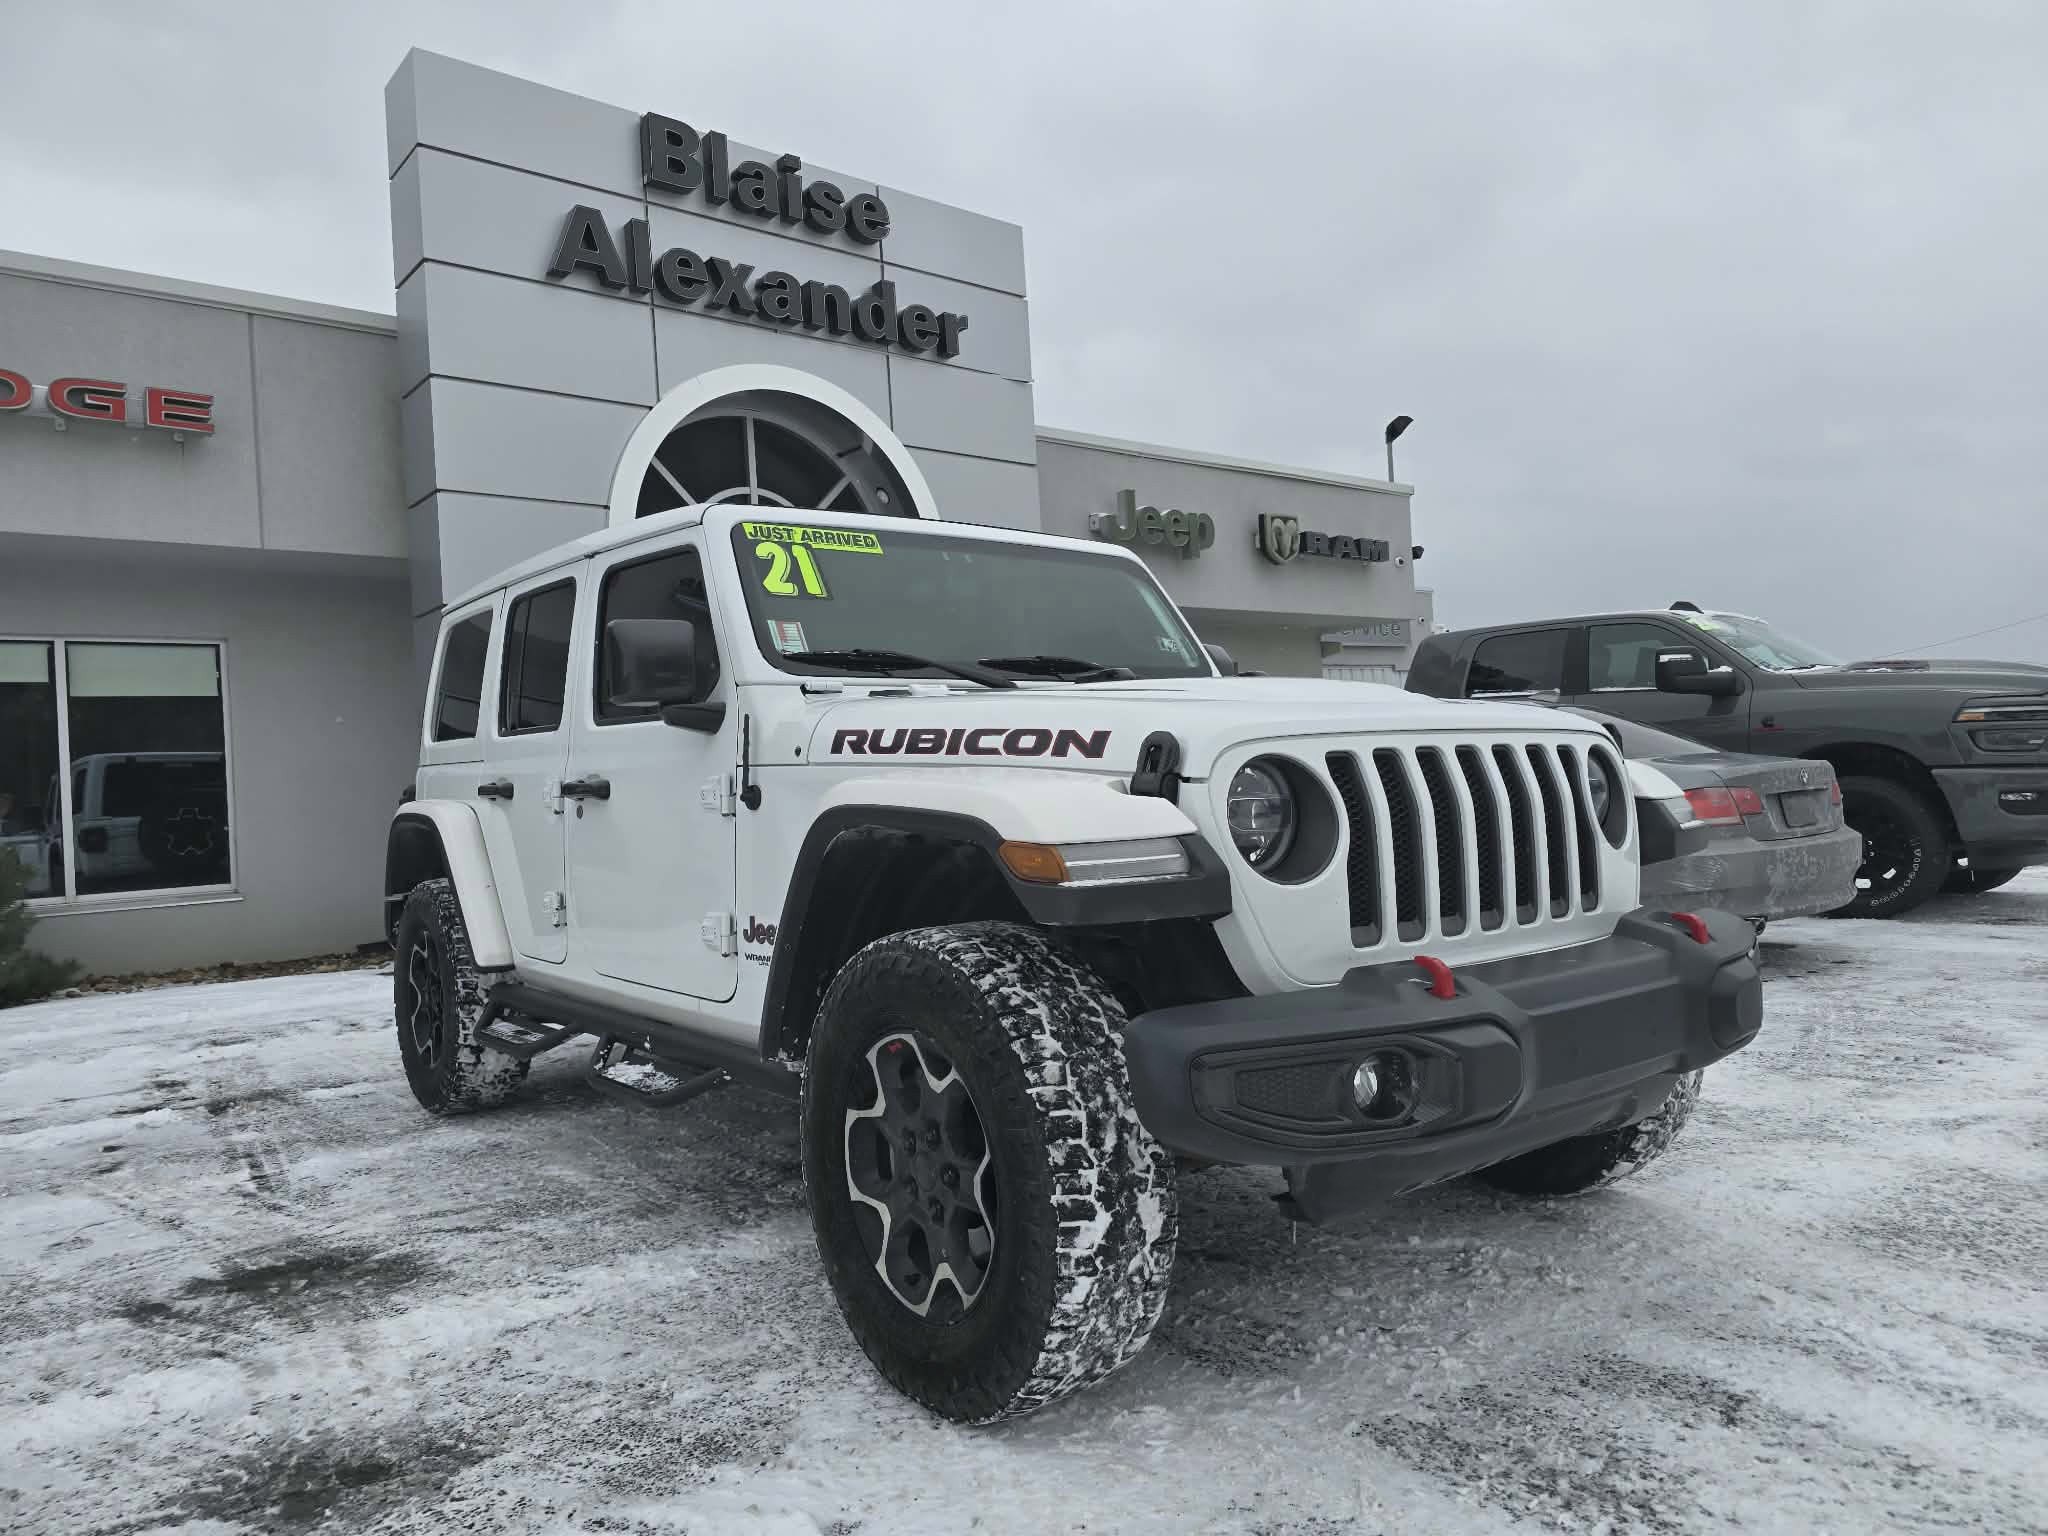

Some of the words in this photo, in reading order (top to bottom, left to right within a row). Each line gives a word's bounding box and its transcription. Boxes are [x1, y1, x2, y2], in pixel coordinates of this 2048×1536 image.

[641, 111, 892, 244] Blaise
[547, 204, 969, 358] Alexander
[749, 525, 794, 541] JUST
[800, 530, 878, 549] ARRIVED
[1088, 489, 1215, 559] Jeep
[1299, 531, 1390, 562] RAM
[755, 541, 828, 598] 21
[829, 727, 1112, 760] RUBICON
[743, 915, 778, 946] Jee
